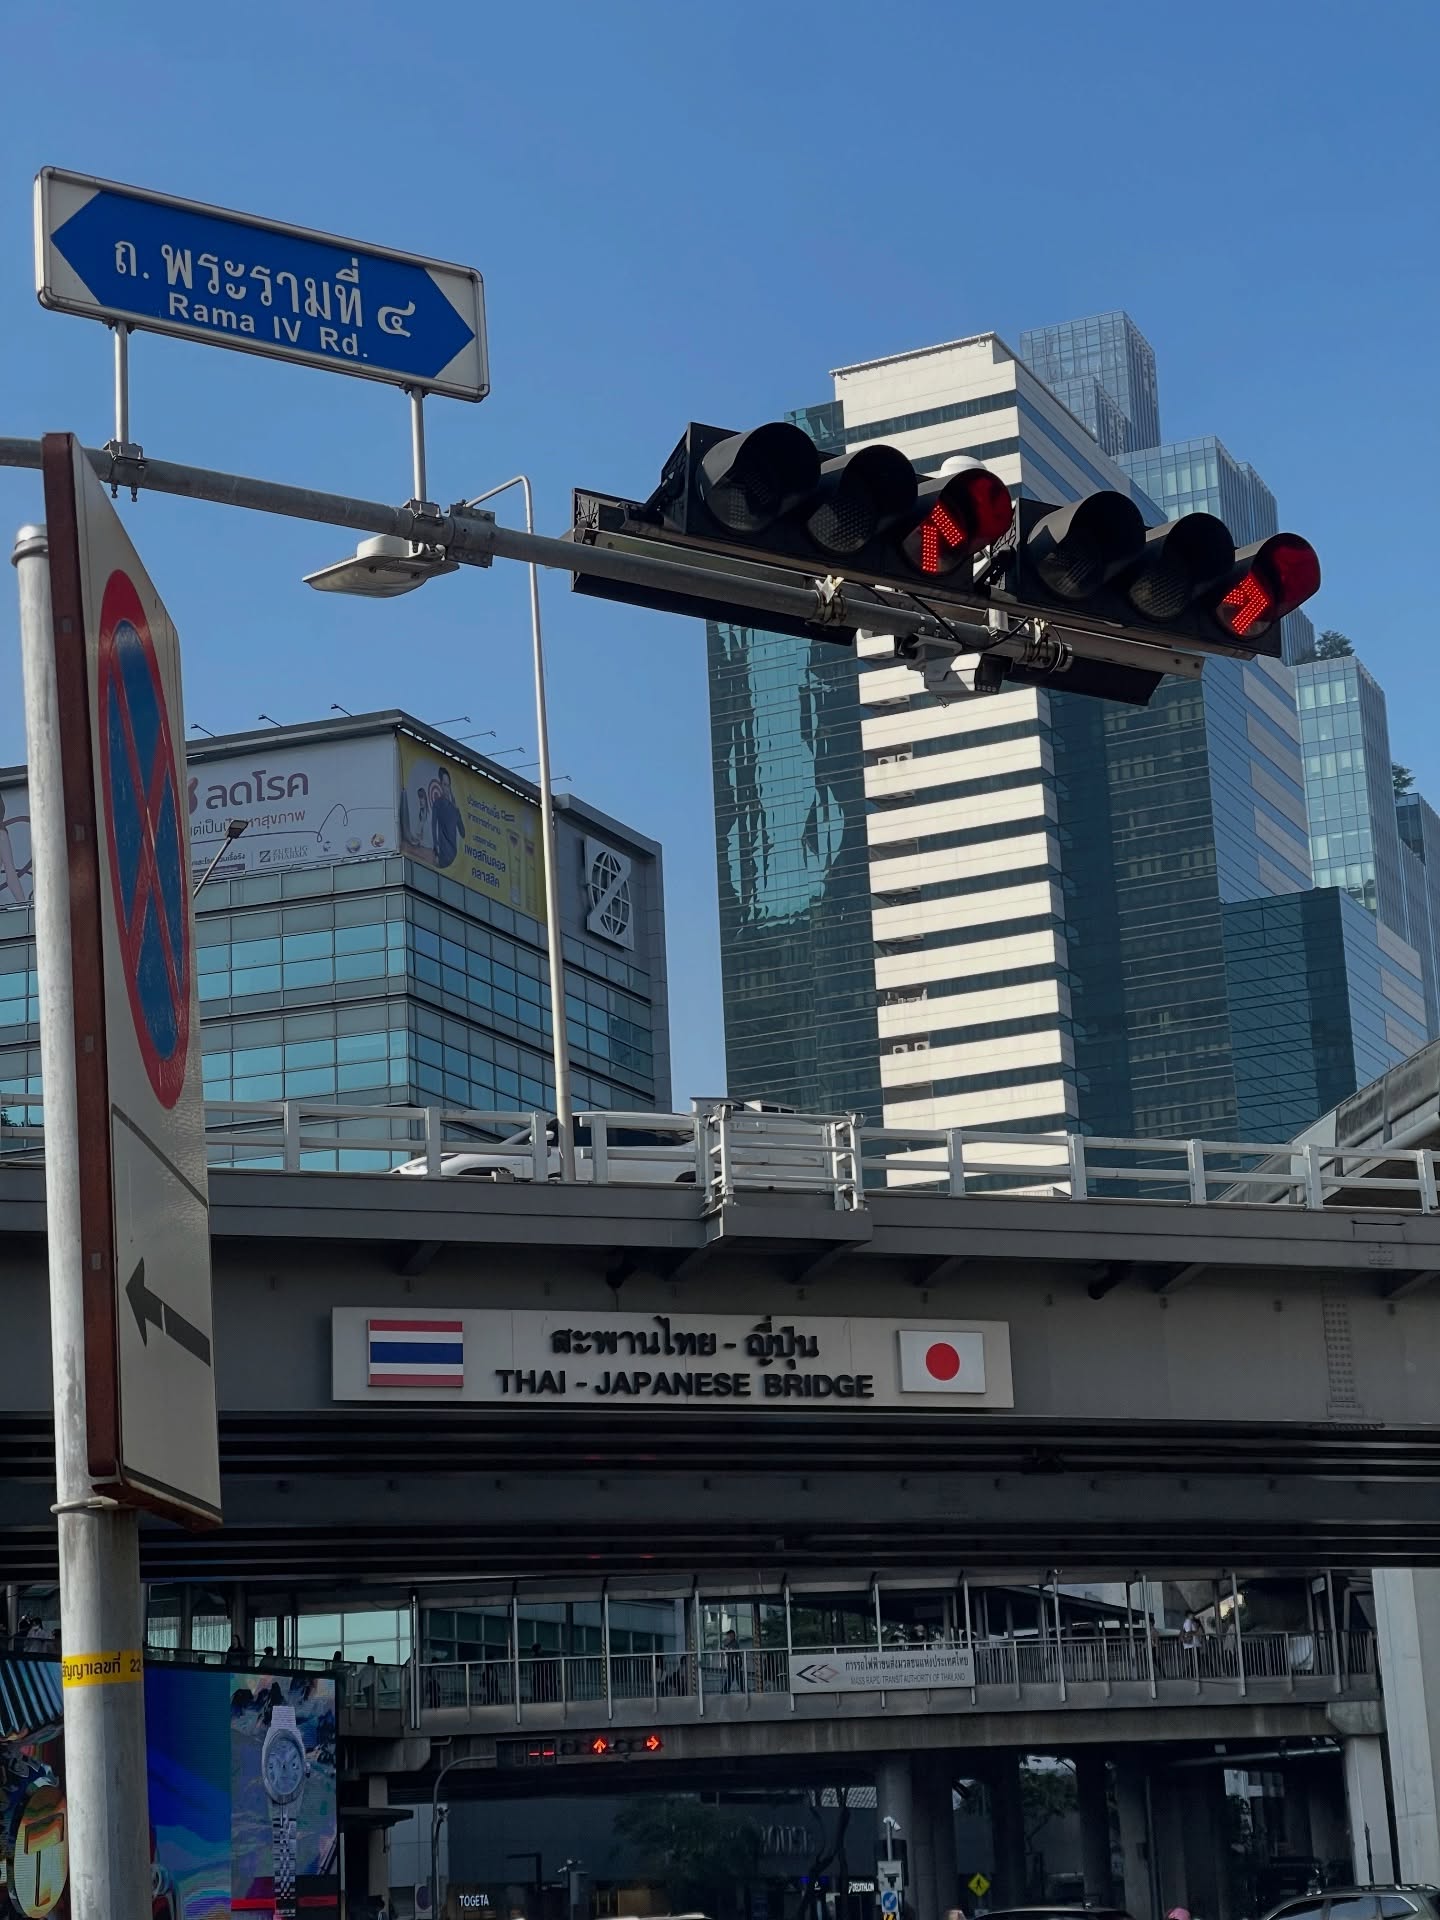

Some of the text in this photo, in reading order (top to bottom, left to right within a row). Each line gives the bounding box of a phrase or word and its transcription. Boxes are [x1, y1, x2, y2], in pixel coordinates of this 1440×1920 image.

[115, 240, 416, 338] ถ. พระรามที่ ๔
[168, 293, 369, 358] Rama IV Rd.
[206, 770, 309, 809] ลดโรค
[551, 1315, 717, 1357] สะพานไทย
[495, 1369, 566, 1394] THAI
[594, 1371, 751, 1397] JAPANESE
[763, 1373, 874, 1398] BRIDGE
[845, 1651, 969, 1671] การรถไฟฟ้าขนส่งมวลชนแห่งประเทศไทย
[851, 1672, 966, 1685] MASS RAPID TRANSIT AUTHORITY OF THAILAND
[459, 1894, 490, 1908] TOGETA
